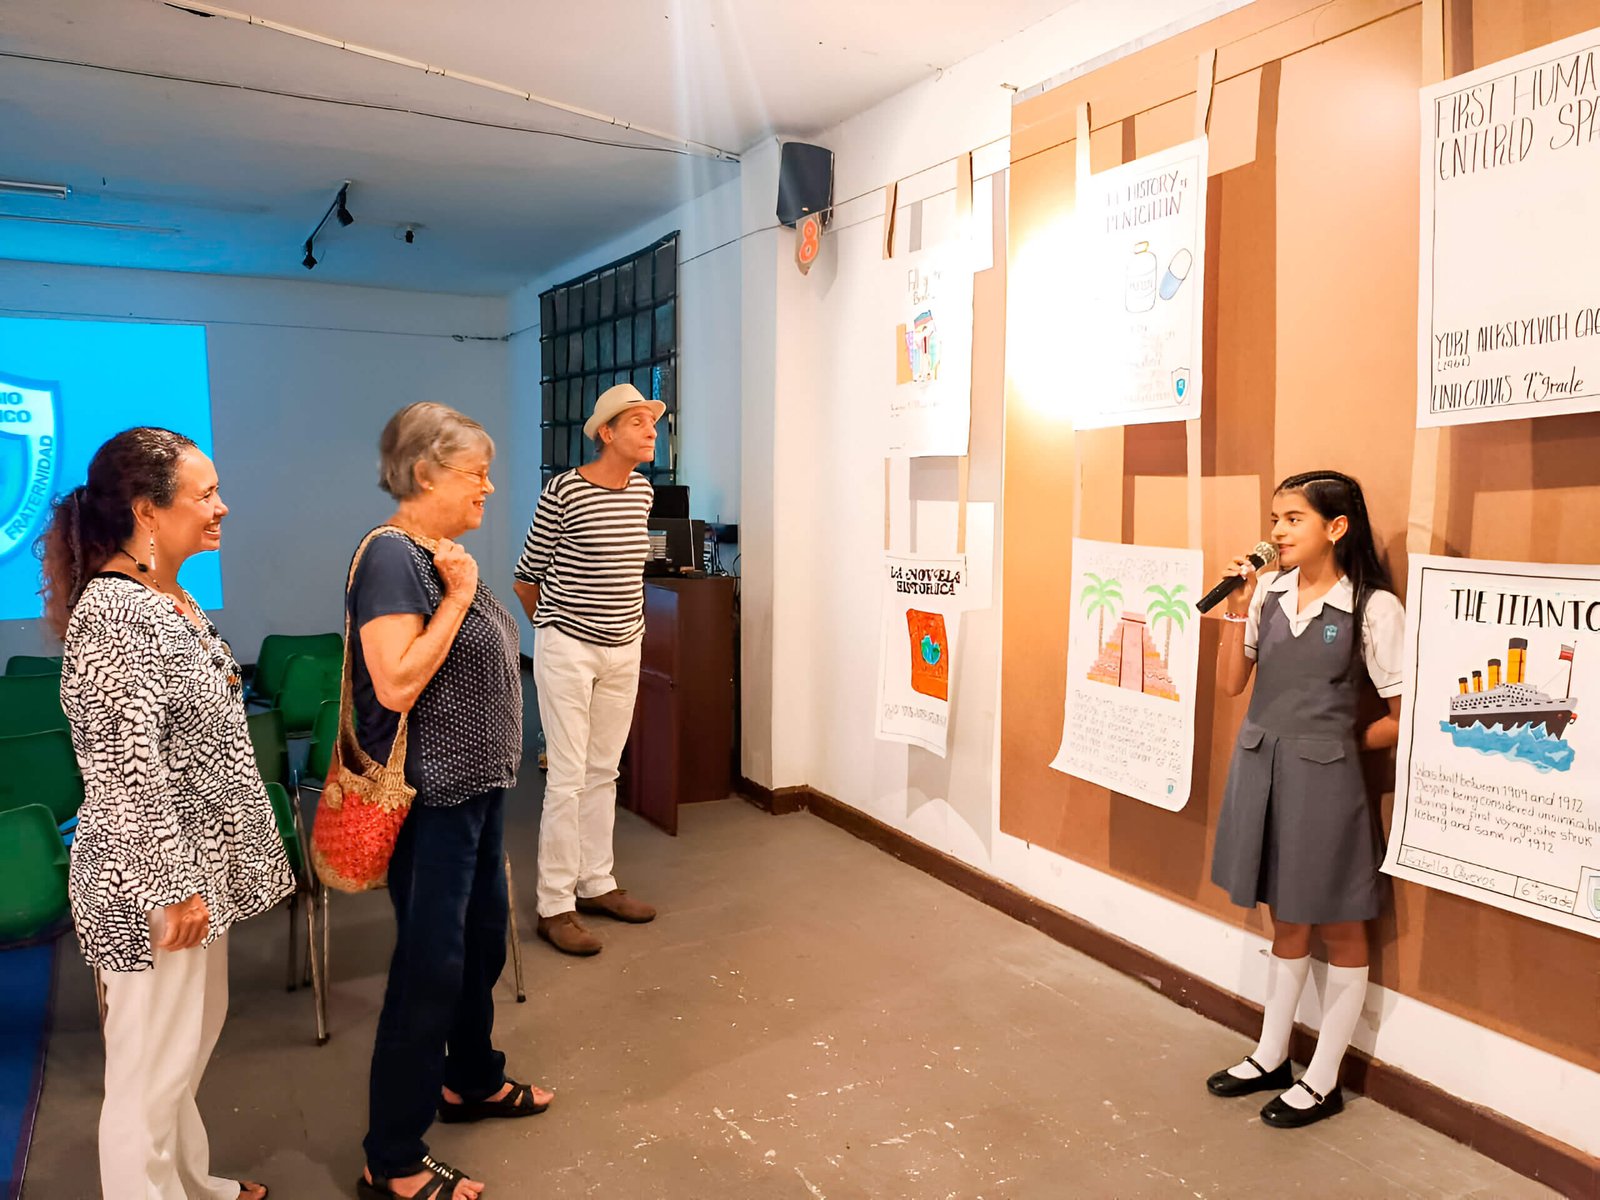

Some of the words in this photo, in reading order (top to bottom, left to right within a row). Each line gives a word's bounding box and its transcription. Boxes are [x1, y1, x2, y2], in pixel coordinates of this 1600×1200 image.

[1437, 81, 1497, 138] FIRST
[799, 219, 818, 263] 8
[1434, 329, 1470, 359] YURI
[4, 434, 54, 541] FRATERNIDAD
[890, 566, 903, 579] LA
[1450, 588, 1488, 624] THE
[1452, 787, 1479, 811] being
[1503, 785, 1528, 802] 1909
[1530, 792, 1555, 806] and
[1450, 819, 1470, 831] and
[1528, 838, 1555, 854] 1912
